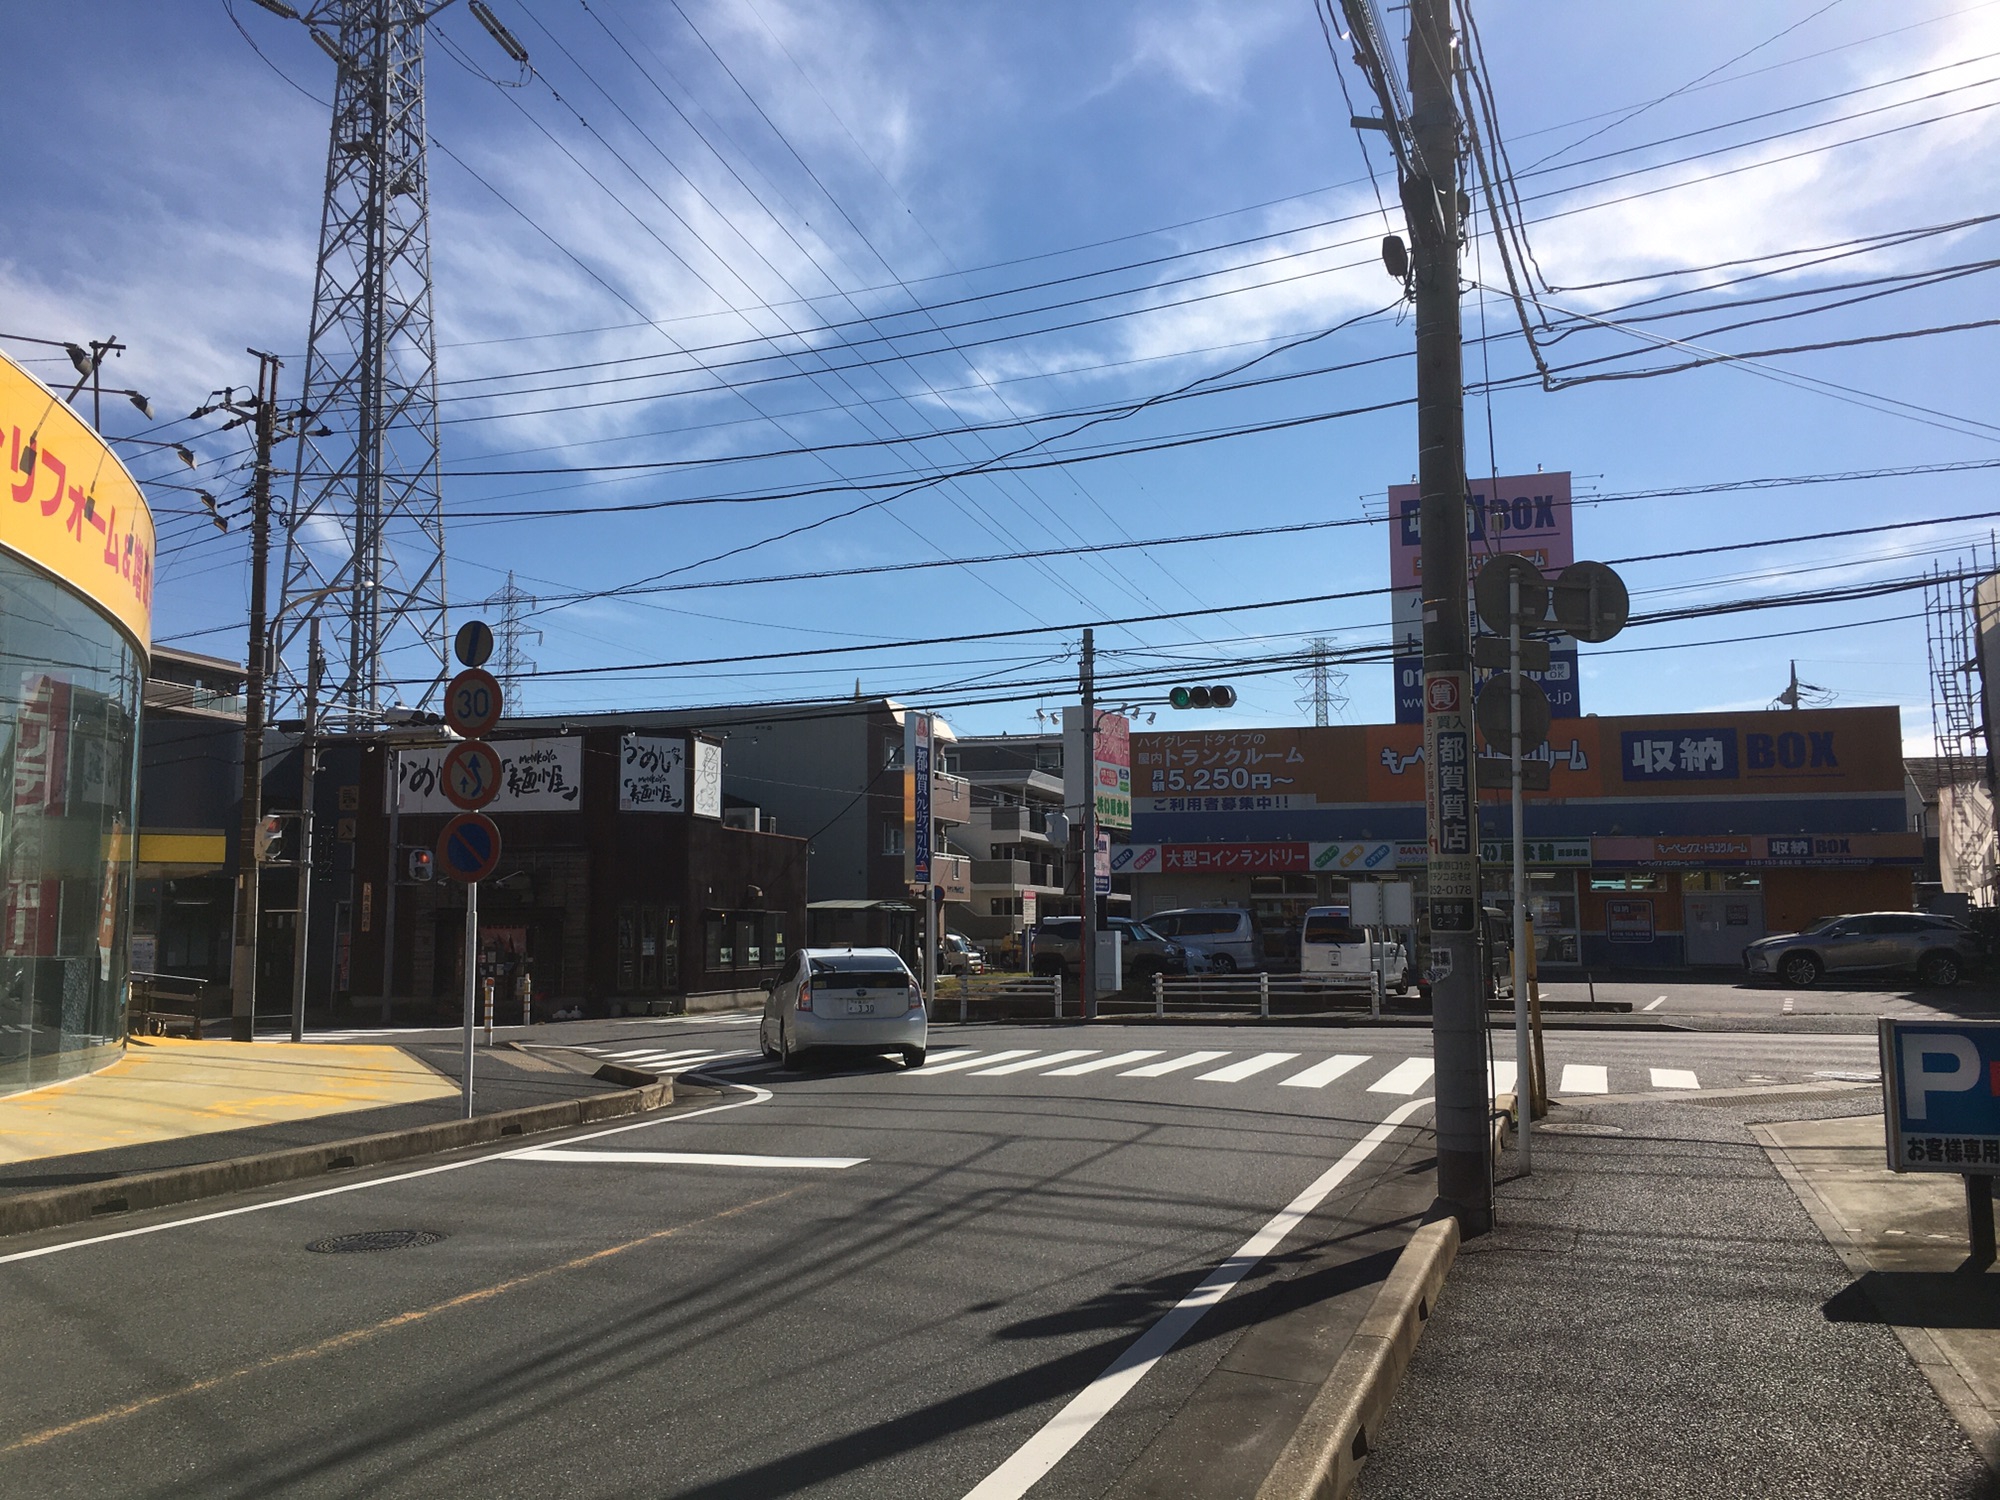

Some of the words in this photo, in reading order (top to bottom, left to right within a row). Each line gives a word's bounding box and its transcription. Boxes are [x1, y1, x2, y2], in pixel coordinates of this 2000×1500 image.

[457, 688, 489, 718] 30
[1430, 684, 1452, 706] 質
[1436, 715, 1466, 730] 買入
[1138, 733, 1266, 748] ハイグレードタイプの
[1632, 736, 1725, 774] 収納
[1746, 731, 1839, 770] BOX
[916, 748, 928, 796] 都賀
[1439, 736, 1467, 850] 都賀質店
[1166, 848, 1305, 868] 大型コインランドリー
[1399, 847, 1428, 855] SANY
[1437, 917, 1459, 927] 2-7
[1902, 1033, 1982, 1120] P
[1907, 1137, 2000, 1165] お客様専用
